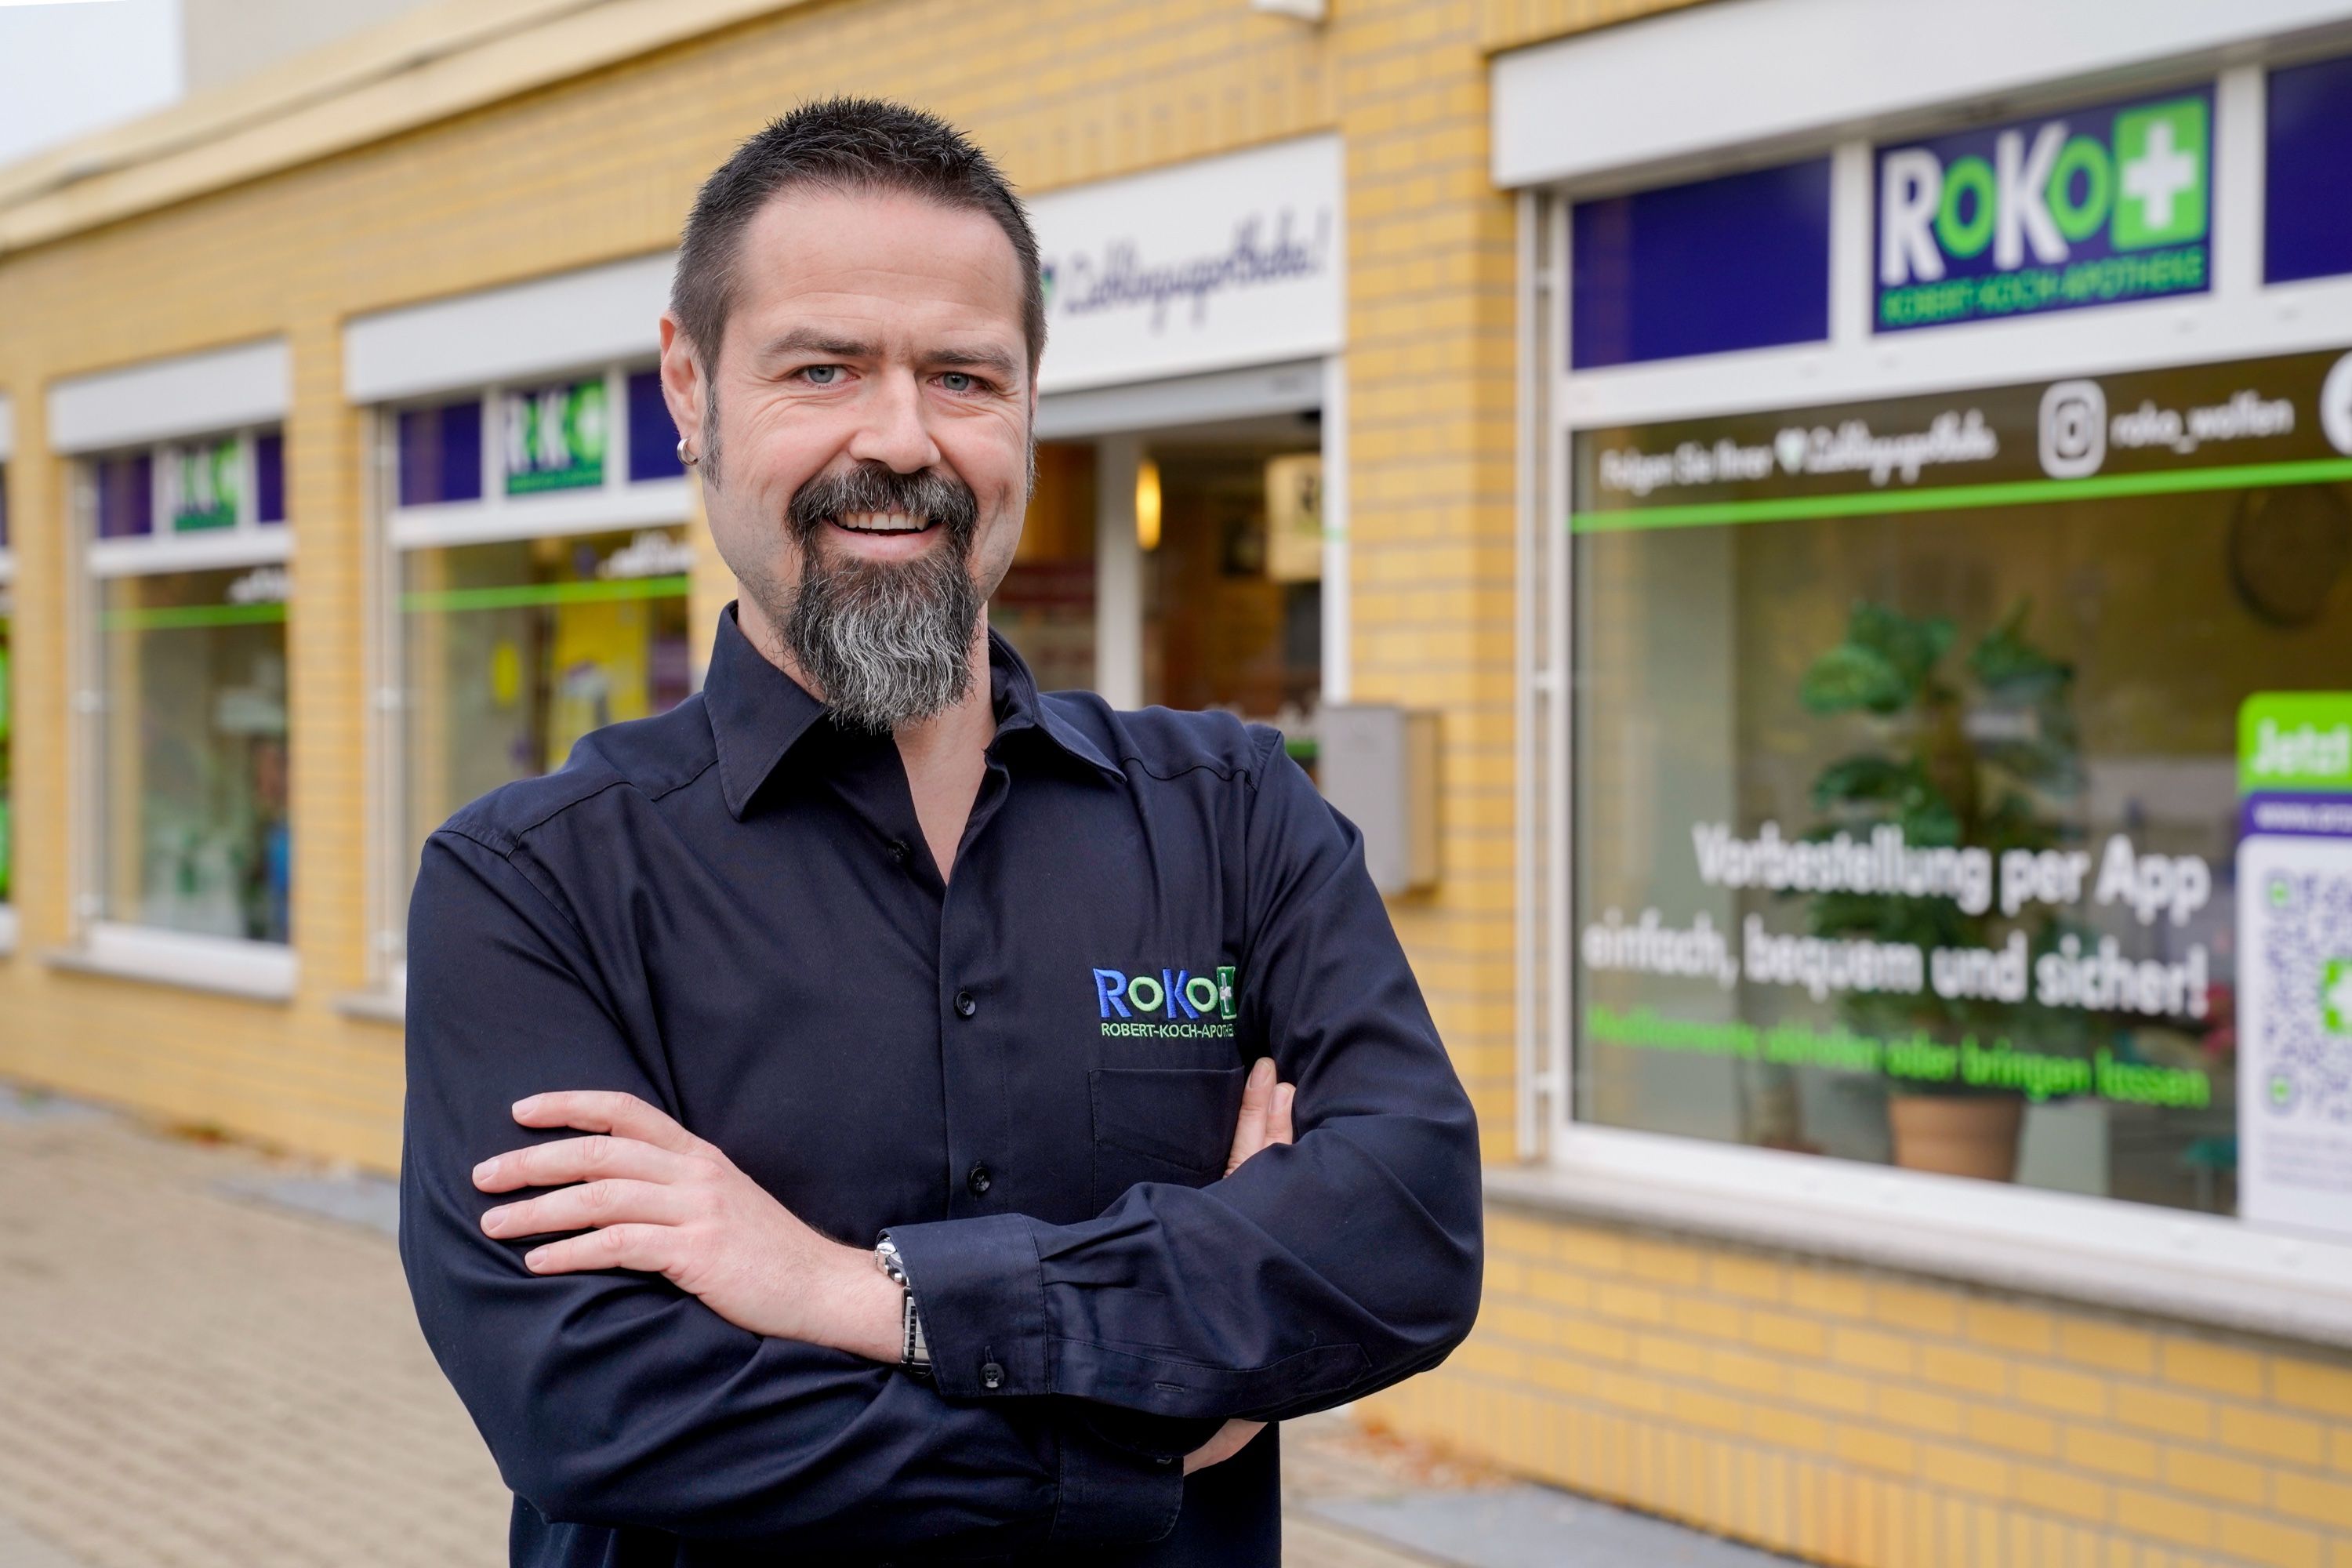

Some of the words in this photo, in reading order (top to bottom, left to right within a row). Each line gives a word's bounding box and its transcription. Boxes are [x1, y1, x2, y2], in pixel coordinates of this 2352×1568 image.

[2253, 717, 2350, 778] Jetzt
[1692, 820, 1991, 915] Vorbestellung
[2000, 848, 2090, 915] per
[2096, 833, 2212, 924] App
[1743, 913, 1924, 1000] bequem
[1931, 931, 2028, 1003] und
[2036, 938, 2209, 1018] sicher!
[1961, 1034, 2092, 1102] bringen
[2094, 1047, 2211, 1109] lassen
